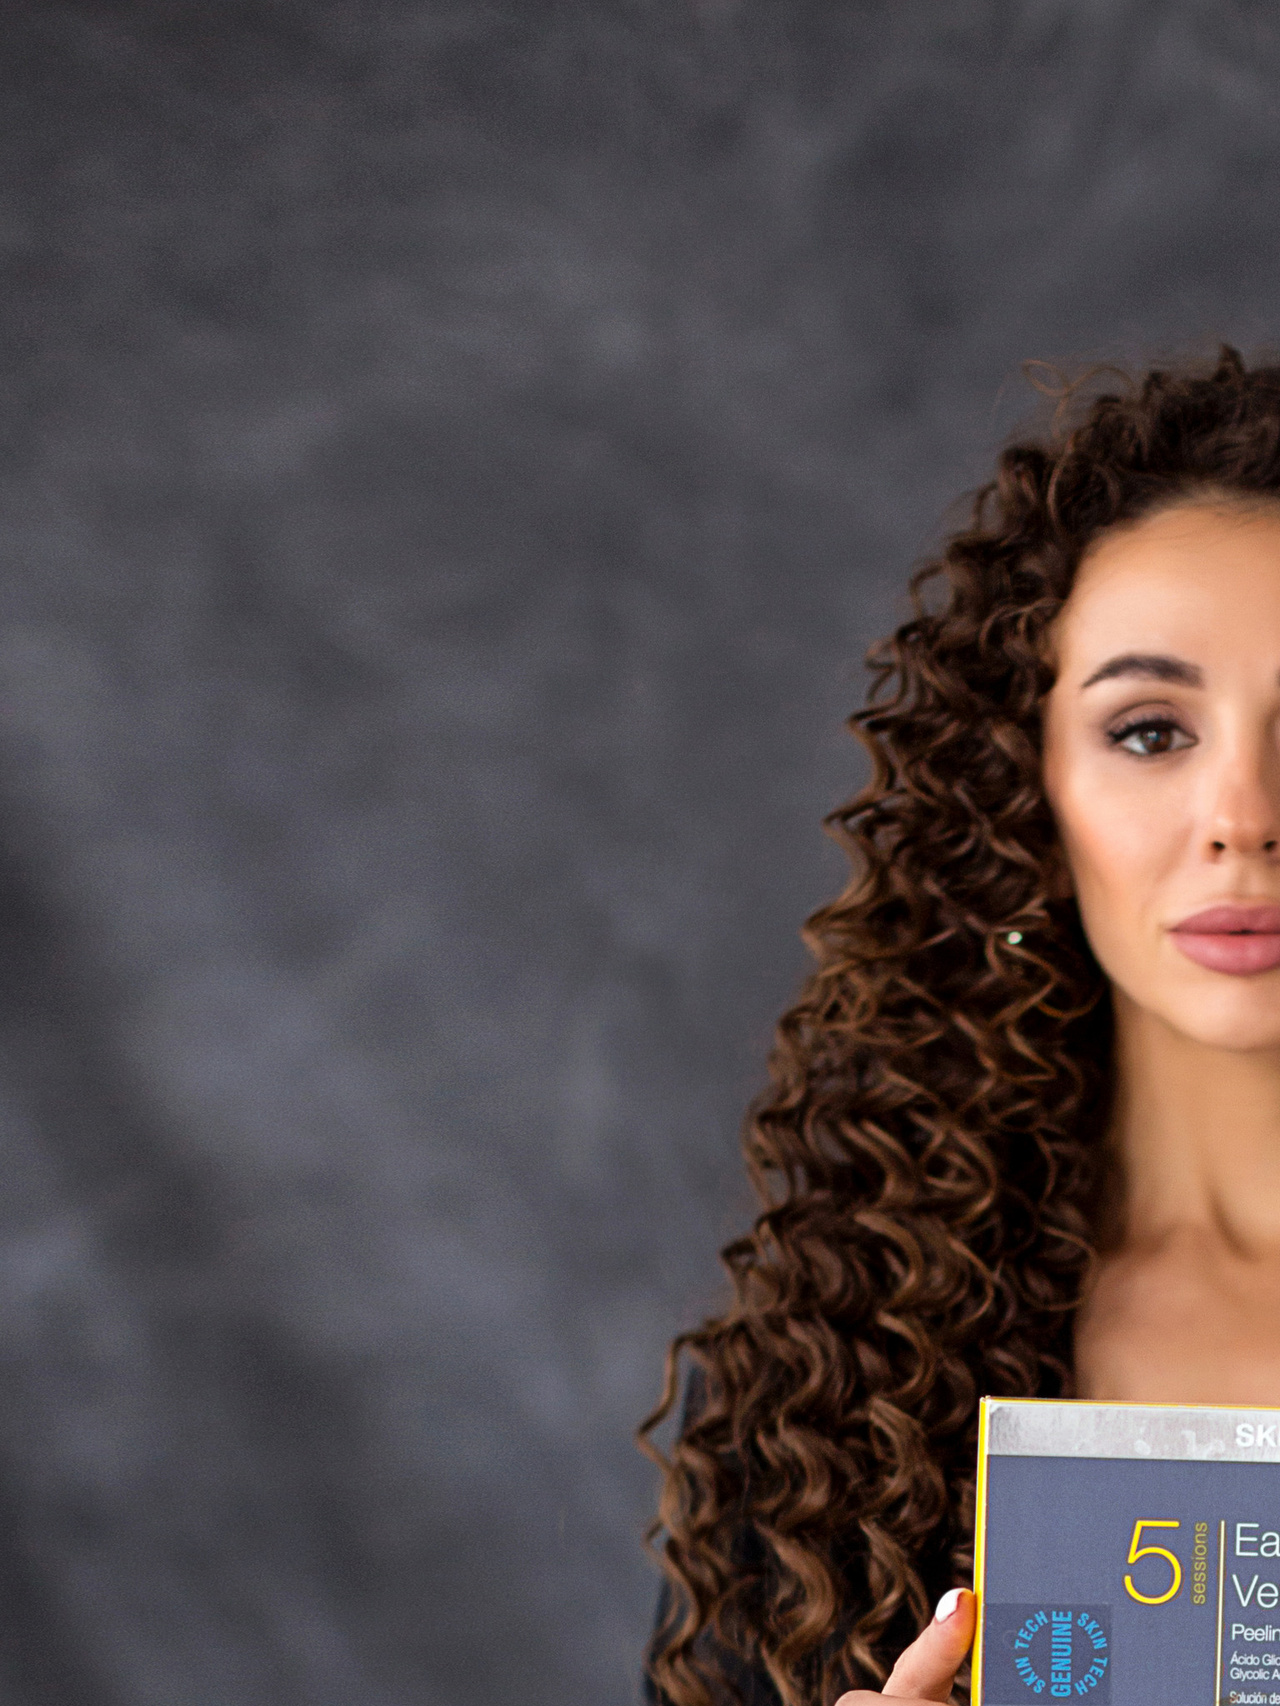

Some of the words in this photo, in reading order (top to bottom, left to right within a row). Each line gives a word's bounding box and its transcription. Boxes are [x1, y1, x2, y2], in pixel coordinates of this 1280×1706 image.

[1123, 1519, 1182, 1605] 5
[1192, 1521, 1209, 1605] sessions
[1014, 1610, 1049, 1650] TECH
[1076, 1612, 1108, 1650] SKIN
[1050, 1610, 1073, 1698] GENUINE
[1230, 1651, 1260, 1667] Ácido
[1014, 1656, 1047, 1694] SKIN
[1074, 1656, 1108, 1696] TECH
[1230, 1667, 1270, 1681] Glycolic
[1229, 1690, 1267, 1704] Solución
